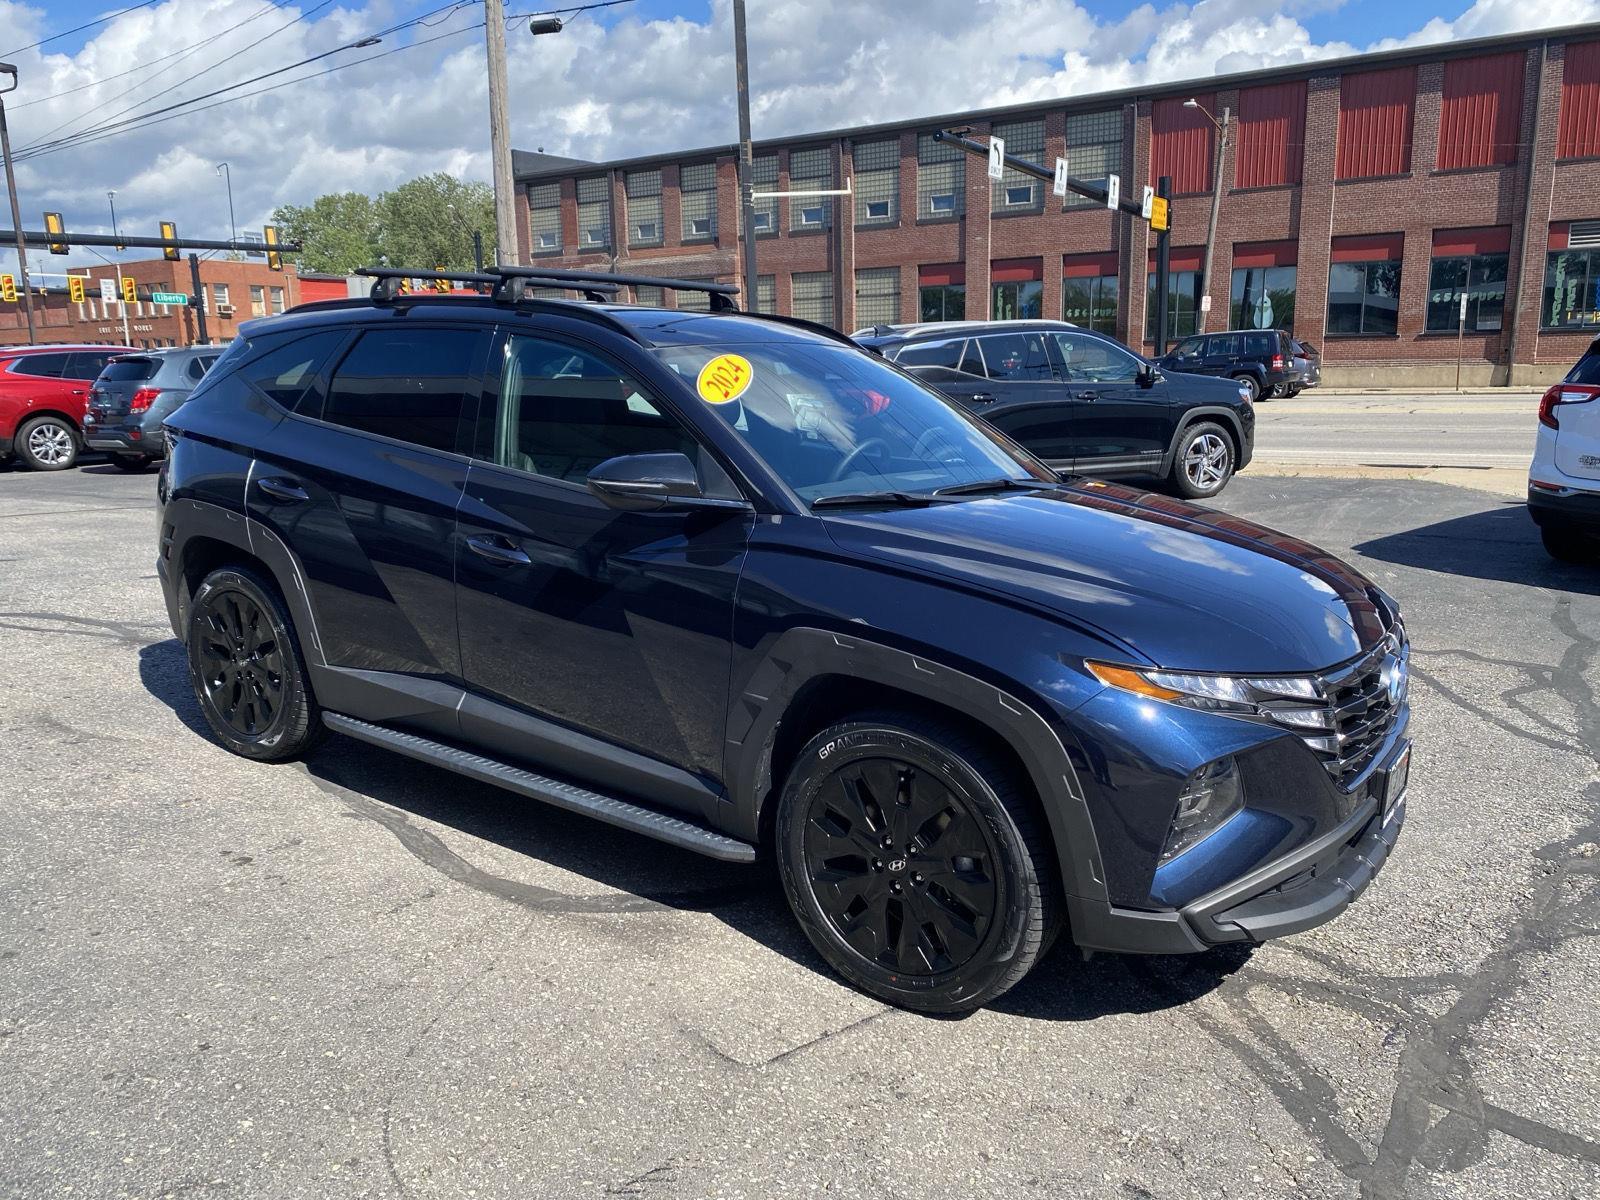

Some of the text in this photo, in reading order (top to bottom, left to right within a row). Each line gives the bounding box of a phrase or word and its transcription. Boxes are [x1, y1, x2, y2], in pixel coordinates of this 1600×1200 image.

[157, 293, 184, 304] Liberty
[133, 324, 153, 332] WORKS
[706, 357, 745, 399] 2024
